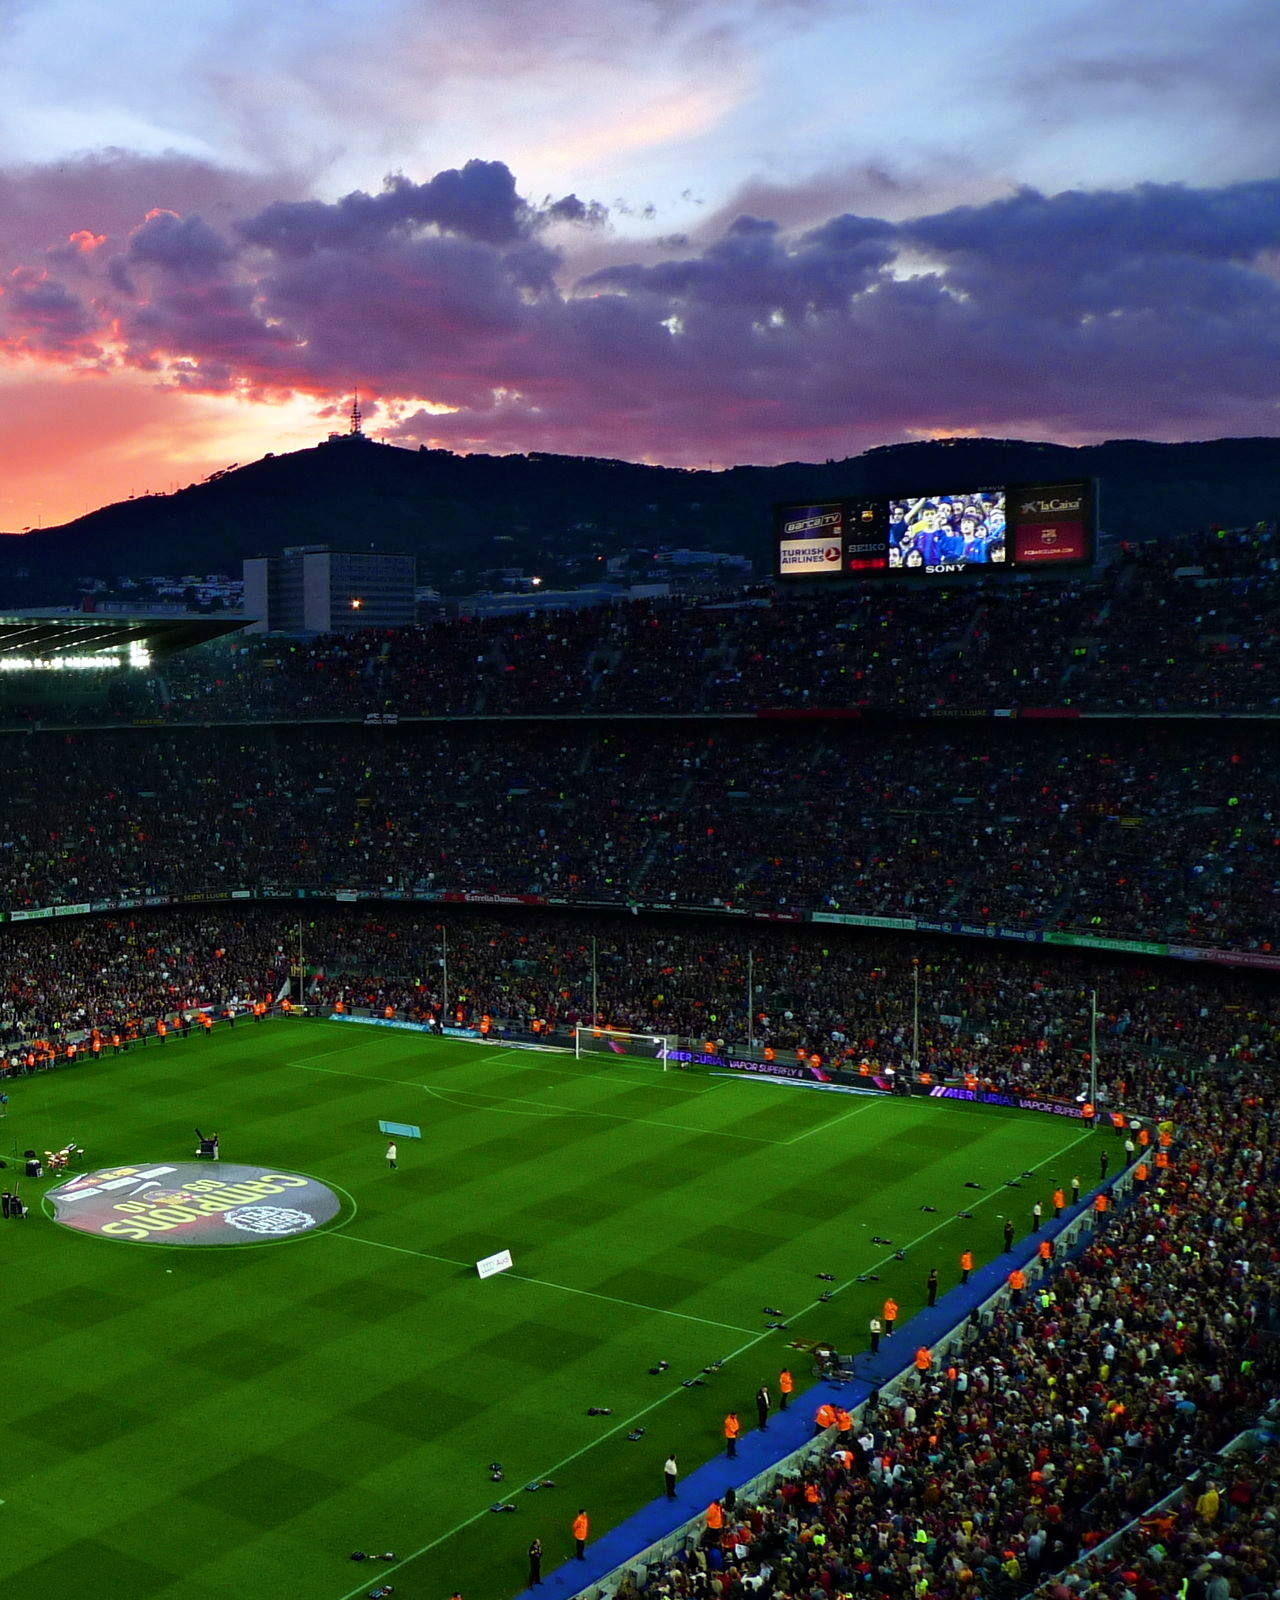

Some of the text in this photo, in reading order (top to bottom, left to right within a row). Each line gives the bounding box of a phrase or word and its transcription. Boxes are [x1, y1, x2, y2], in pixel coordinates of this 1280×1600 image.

[823, 514, 839, 523] TV
[782, 547, 824, 557] TURKISH
[848, 543, 886, 553] SEIKO
[782, 556, 824, 565] AIRLINES
[925, 564, 966, 574] SONY
[729, 1060, 758, 1072] VAPOR
[759, 1062, 797, 1076] SUPERFLY
[1020, 1100, 1053, 1112] VAPOR
[181, 1179, 226, 1192] 09
[101, 1174, 308, 1239] CAMPIONS
[113, 1200, 157, 1213] 10
[495, 1256, 510, 1267] Audi
